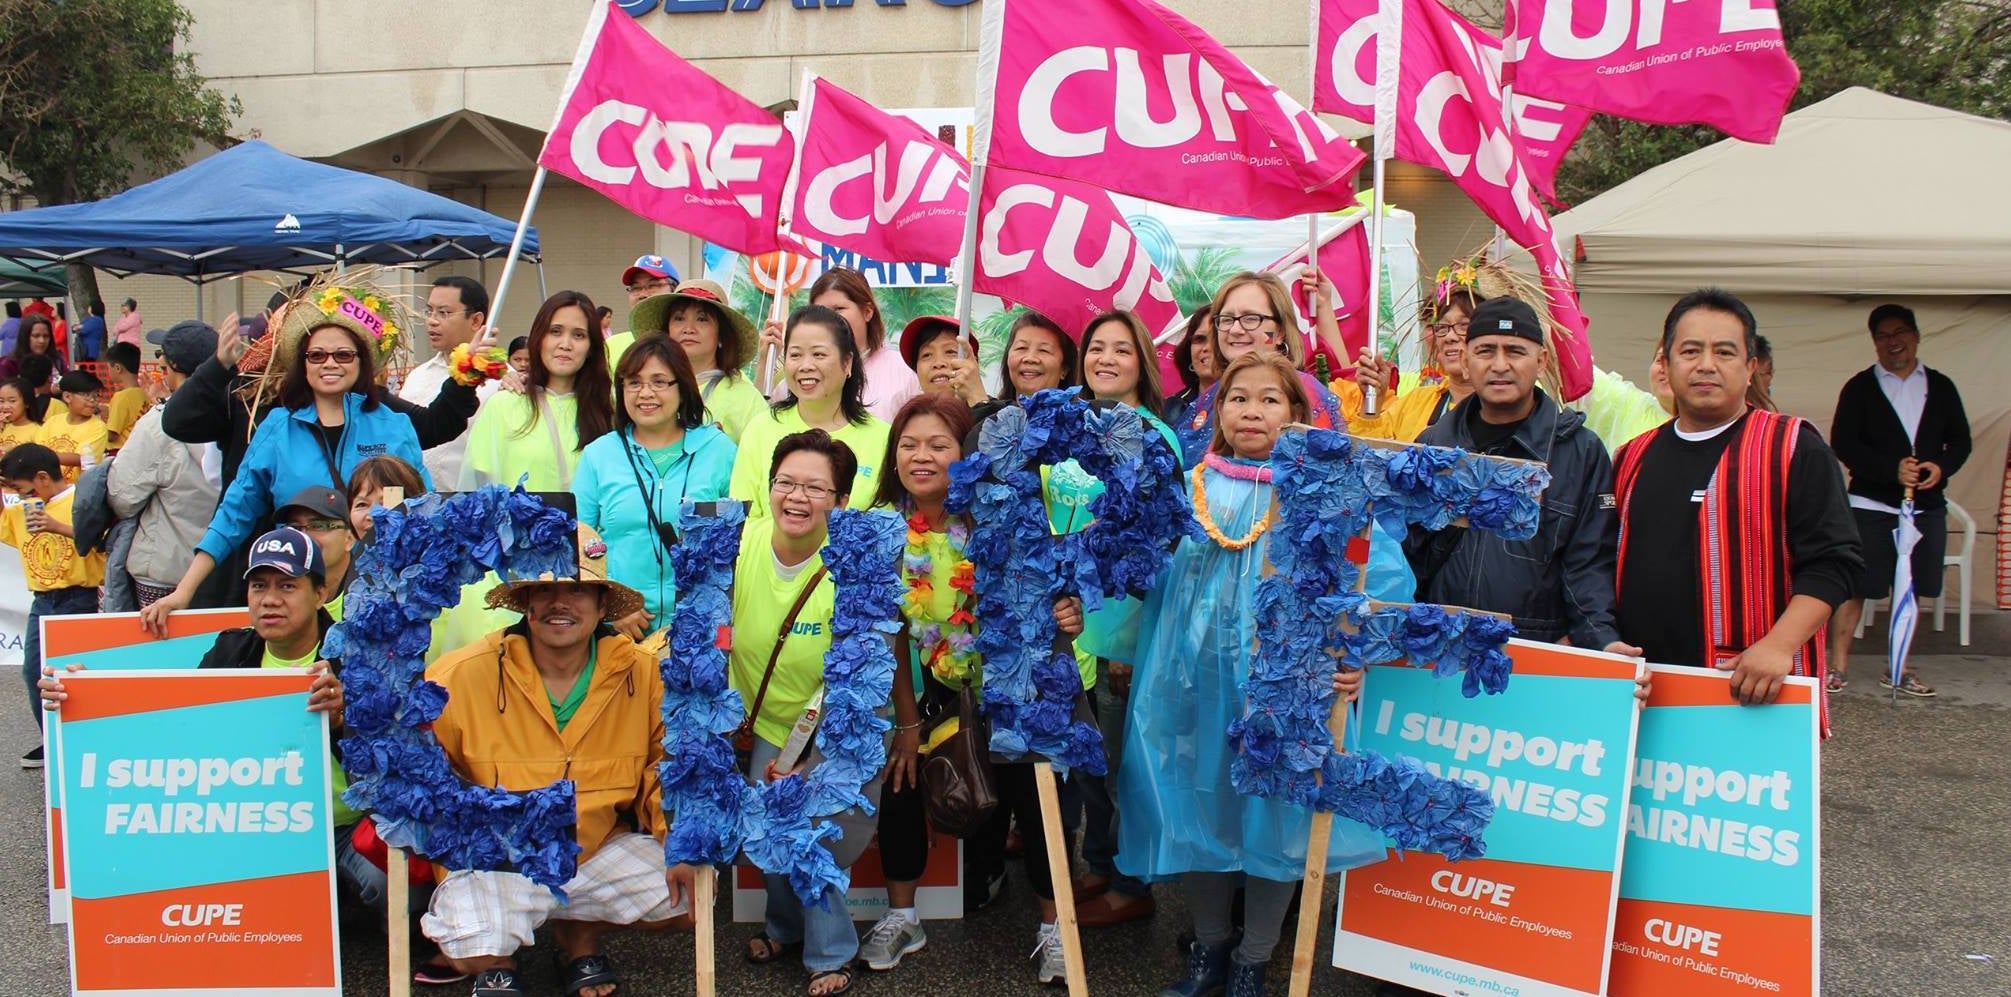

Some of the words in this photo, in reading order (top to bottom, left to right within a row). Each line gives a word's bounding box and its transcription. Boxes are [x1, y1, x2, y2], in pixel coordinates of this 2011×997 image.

[1596, 60, 1645, 75] Canadian
[1647, 52, 1678, 67] Union
[1680, 48, 1693, 60] of
[1695, 43, 1732, 57] Public
[1181, 152, 1229, 165] Canadian
[1250, 156, 1283, 168] Public
[980, 184, 1176, 313] CUP
[341, 301, 383, 335] CUPE
[257, 539, 296, 556] USA
[793, 621, 822, 636] UPE
[1375, 699, 1395, 736] I
[1401, 711, 1606, 777] support
[80, 752, 97, 788] I
[106, 750, 304, 796] support
[1632, 757, 1791, 811] upport
[105, 801, 314, 834] FAIRNESS
[1627, 804, 1800, 867] AIRNESS
[1431, 869, 1515, 908] CUPE
[161, 904, 243, 927] CUPE
[1373, 883, 1423, 904] Canadian
[1425, 895, 1457, 913] Union
[1459, 905, 1472, 916] of
[1473, 907, 1508, 925] Public
[1509, 915, 1573, 940] Employees
[104, 933, 156, 945] Canadian
[159, 932, 193, 944] Union
[194, 932, 206, 943] of
[207, 932, 241, 943] Public
[243, 931, 302, 945] Employees
[1644, 918, 1722, 958] CUPE
[1409, 961, 1520, 997] www.cupe.mb.ca
[1640, 947, 1670, 964] Union
[1672, 956, 1684, 967] of
[1685, 957, 1718, 976] Public
[1719, 966, 1781, 992] Employees
